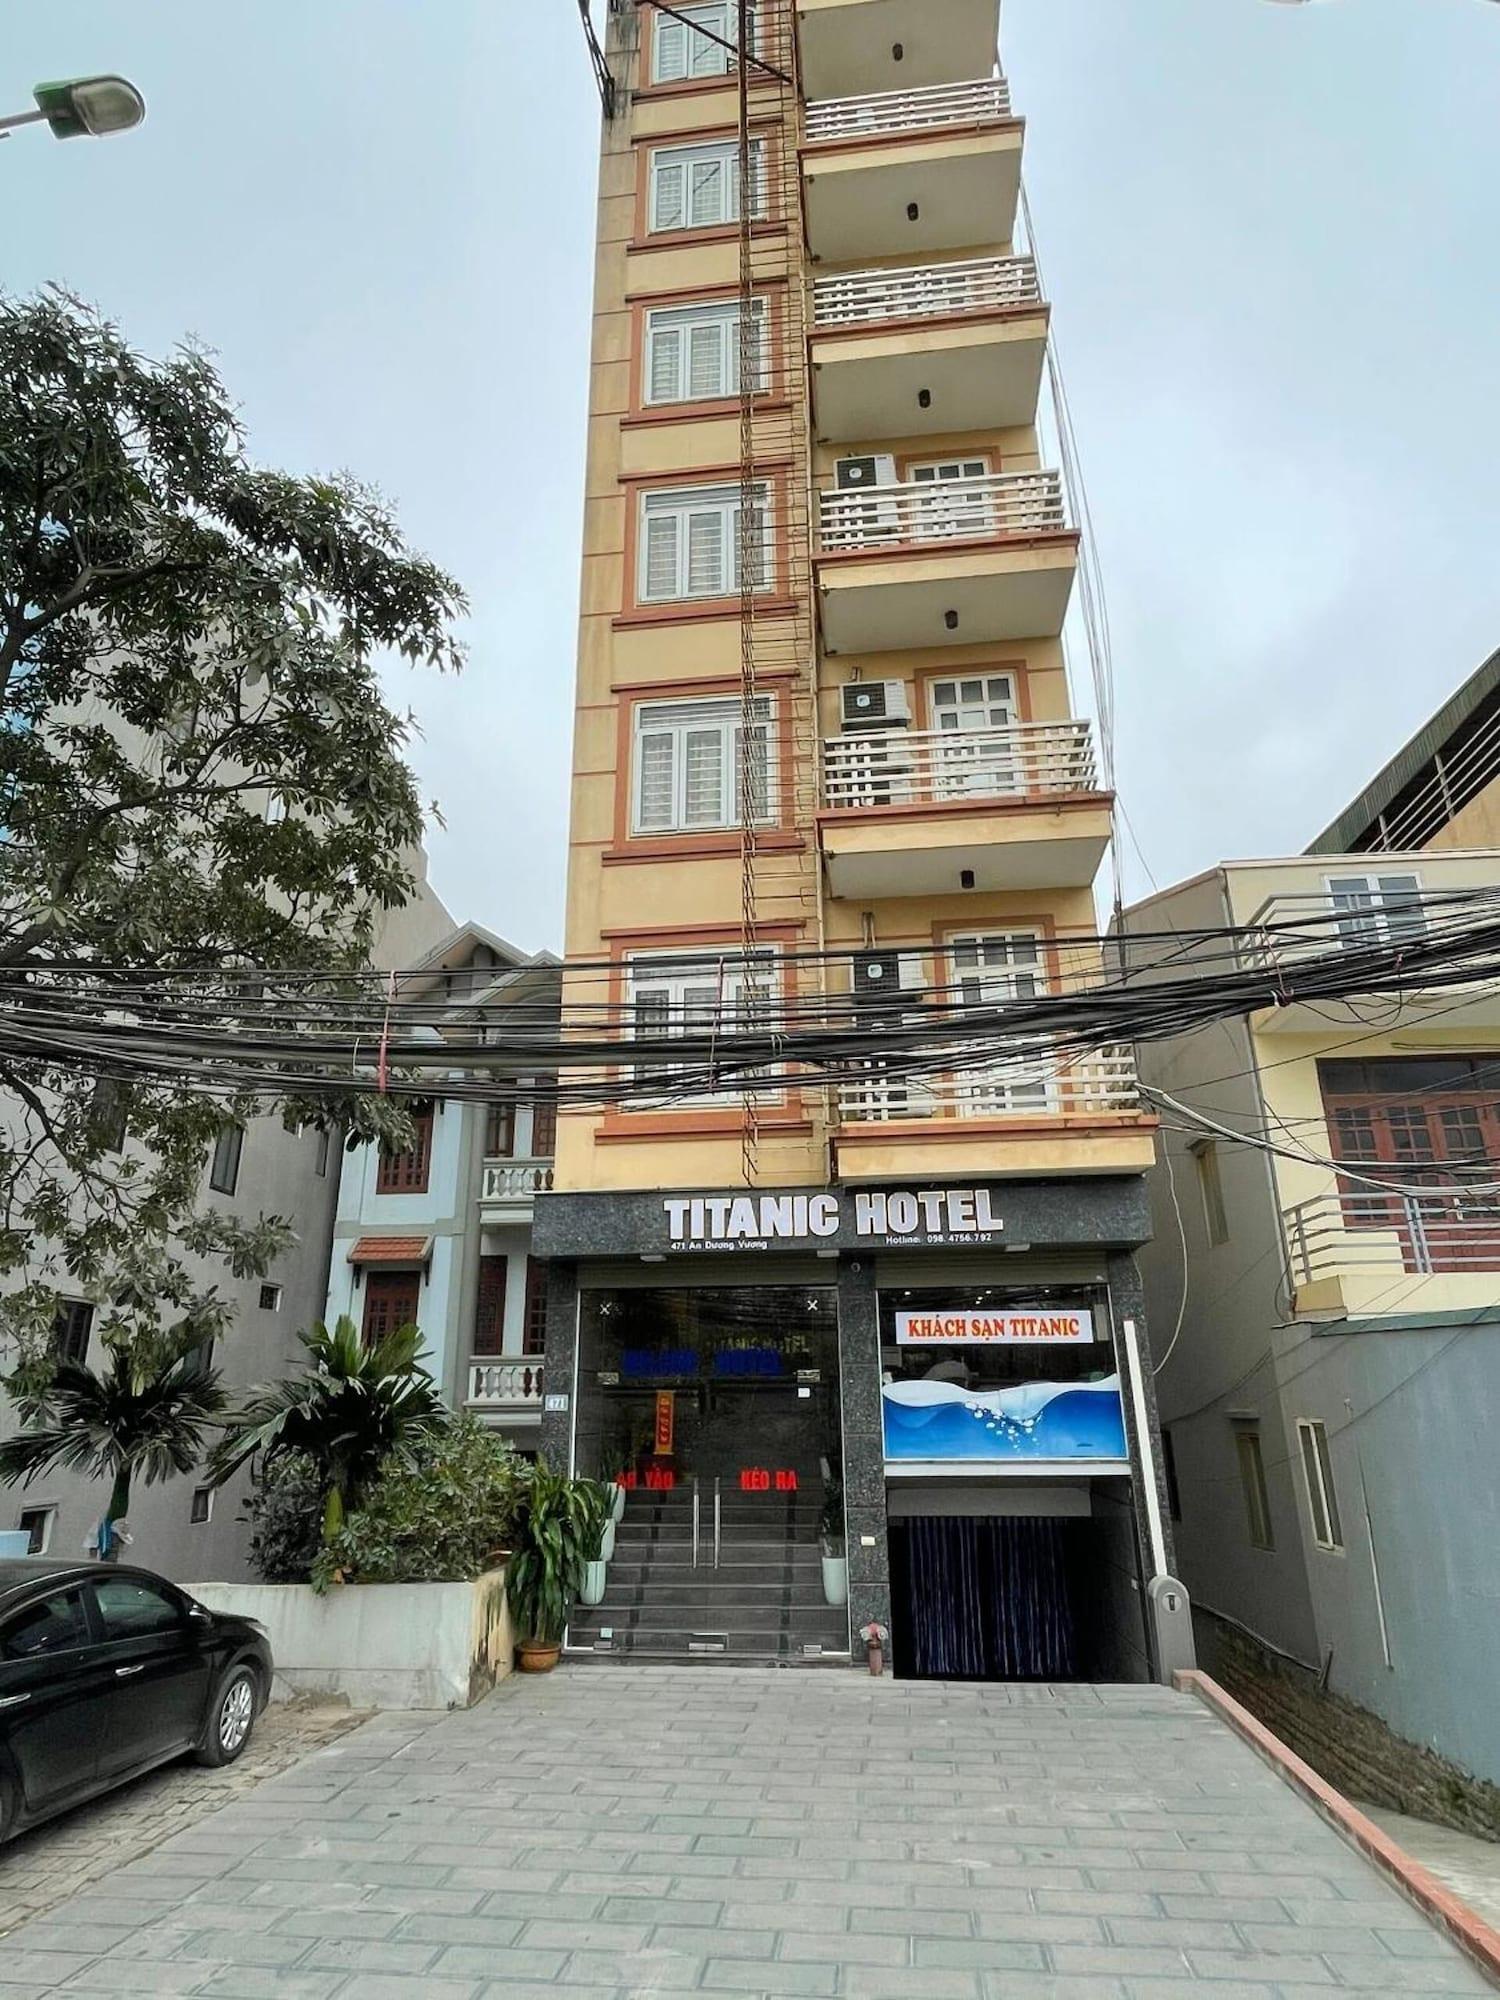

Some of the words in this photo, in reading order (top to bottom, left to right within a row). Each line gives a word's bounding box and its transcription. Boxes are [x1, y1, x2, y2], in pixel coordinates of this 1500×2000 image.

[664, 1194, 839, 1240] TITANIC
[856, 1190, 1004, 1235] HOTEL
[670, 1241, 685, 1250] 471
[688, 1241, 702, 1250] An
[908, 1314, 967, 1337] KHÁCH
[972, 1319, 1005, 1341] SẠN
[1009, 1318, 1080, 1336] TITANIC
